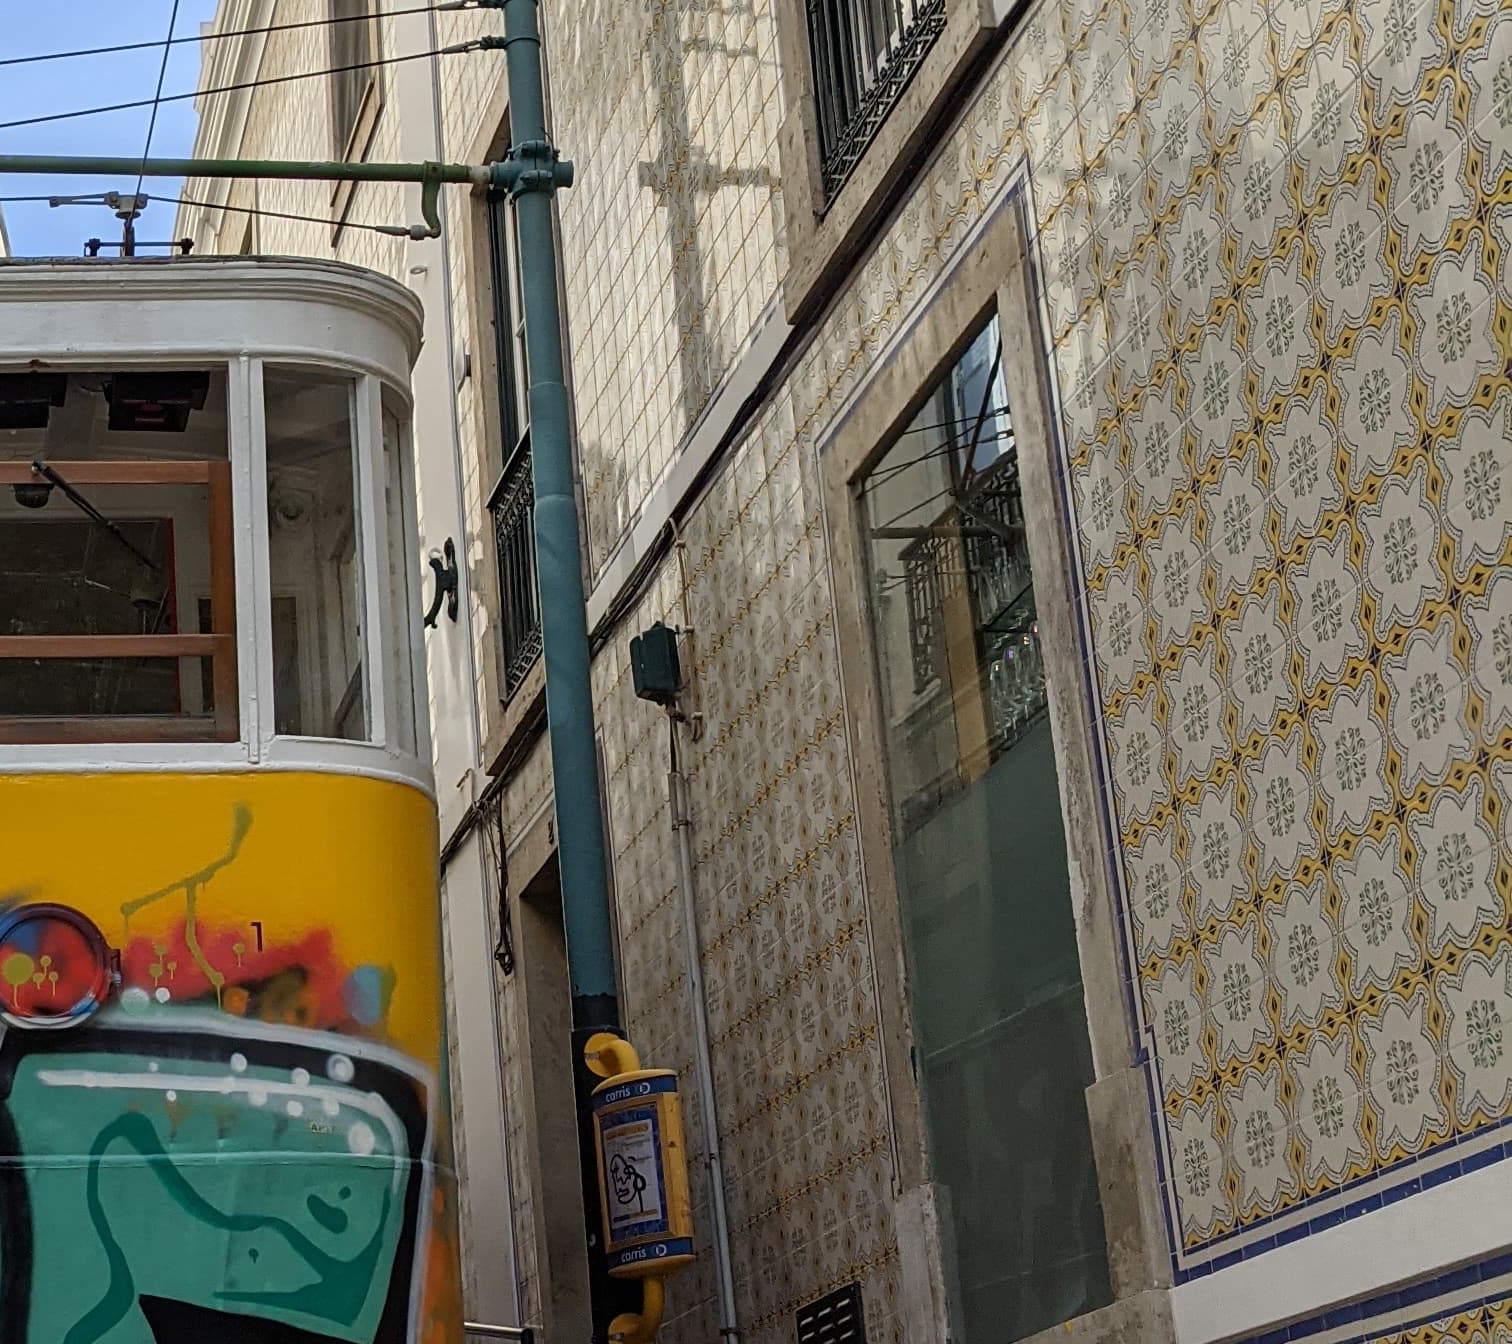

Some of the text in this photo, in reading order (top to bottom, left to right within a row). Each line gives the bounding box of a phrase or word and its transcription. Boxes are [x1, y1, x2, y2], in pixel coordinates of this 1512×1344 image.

[250, 921, 263, 953] 1
[605, 1086, 632, 1103] carris
[621, 1247, 647, 1262] carris
